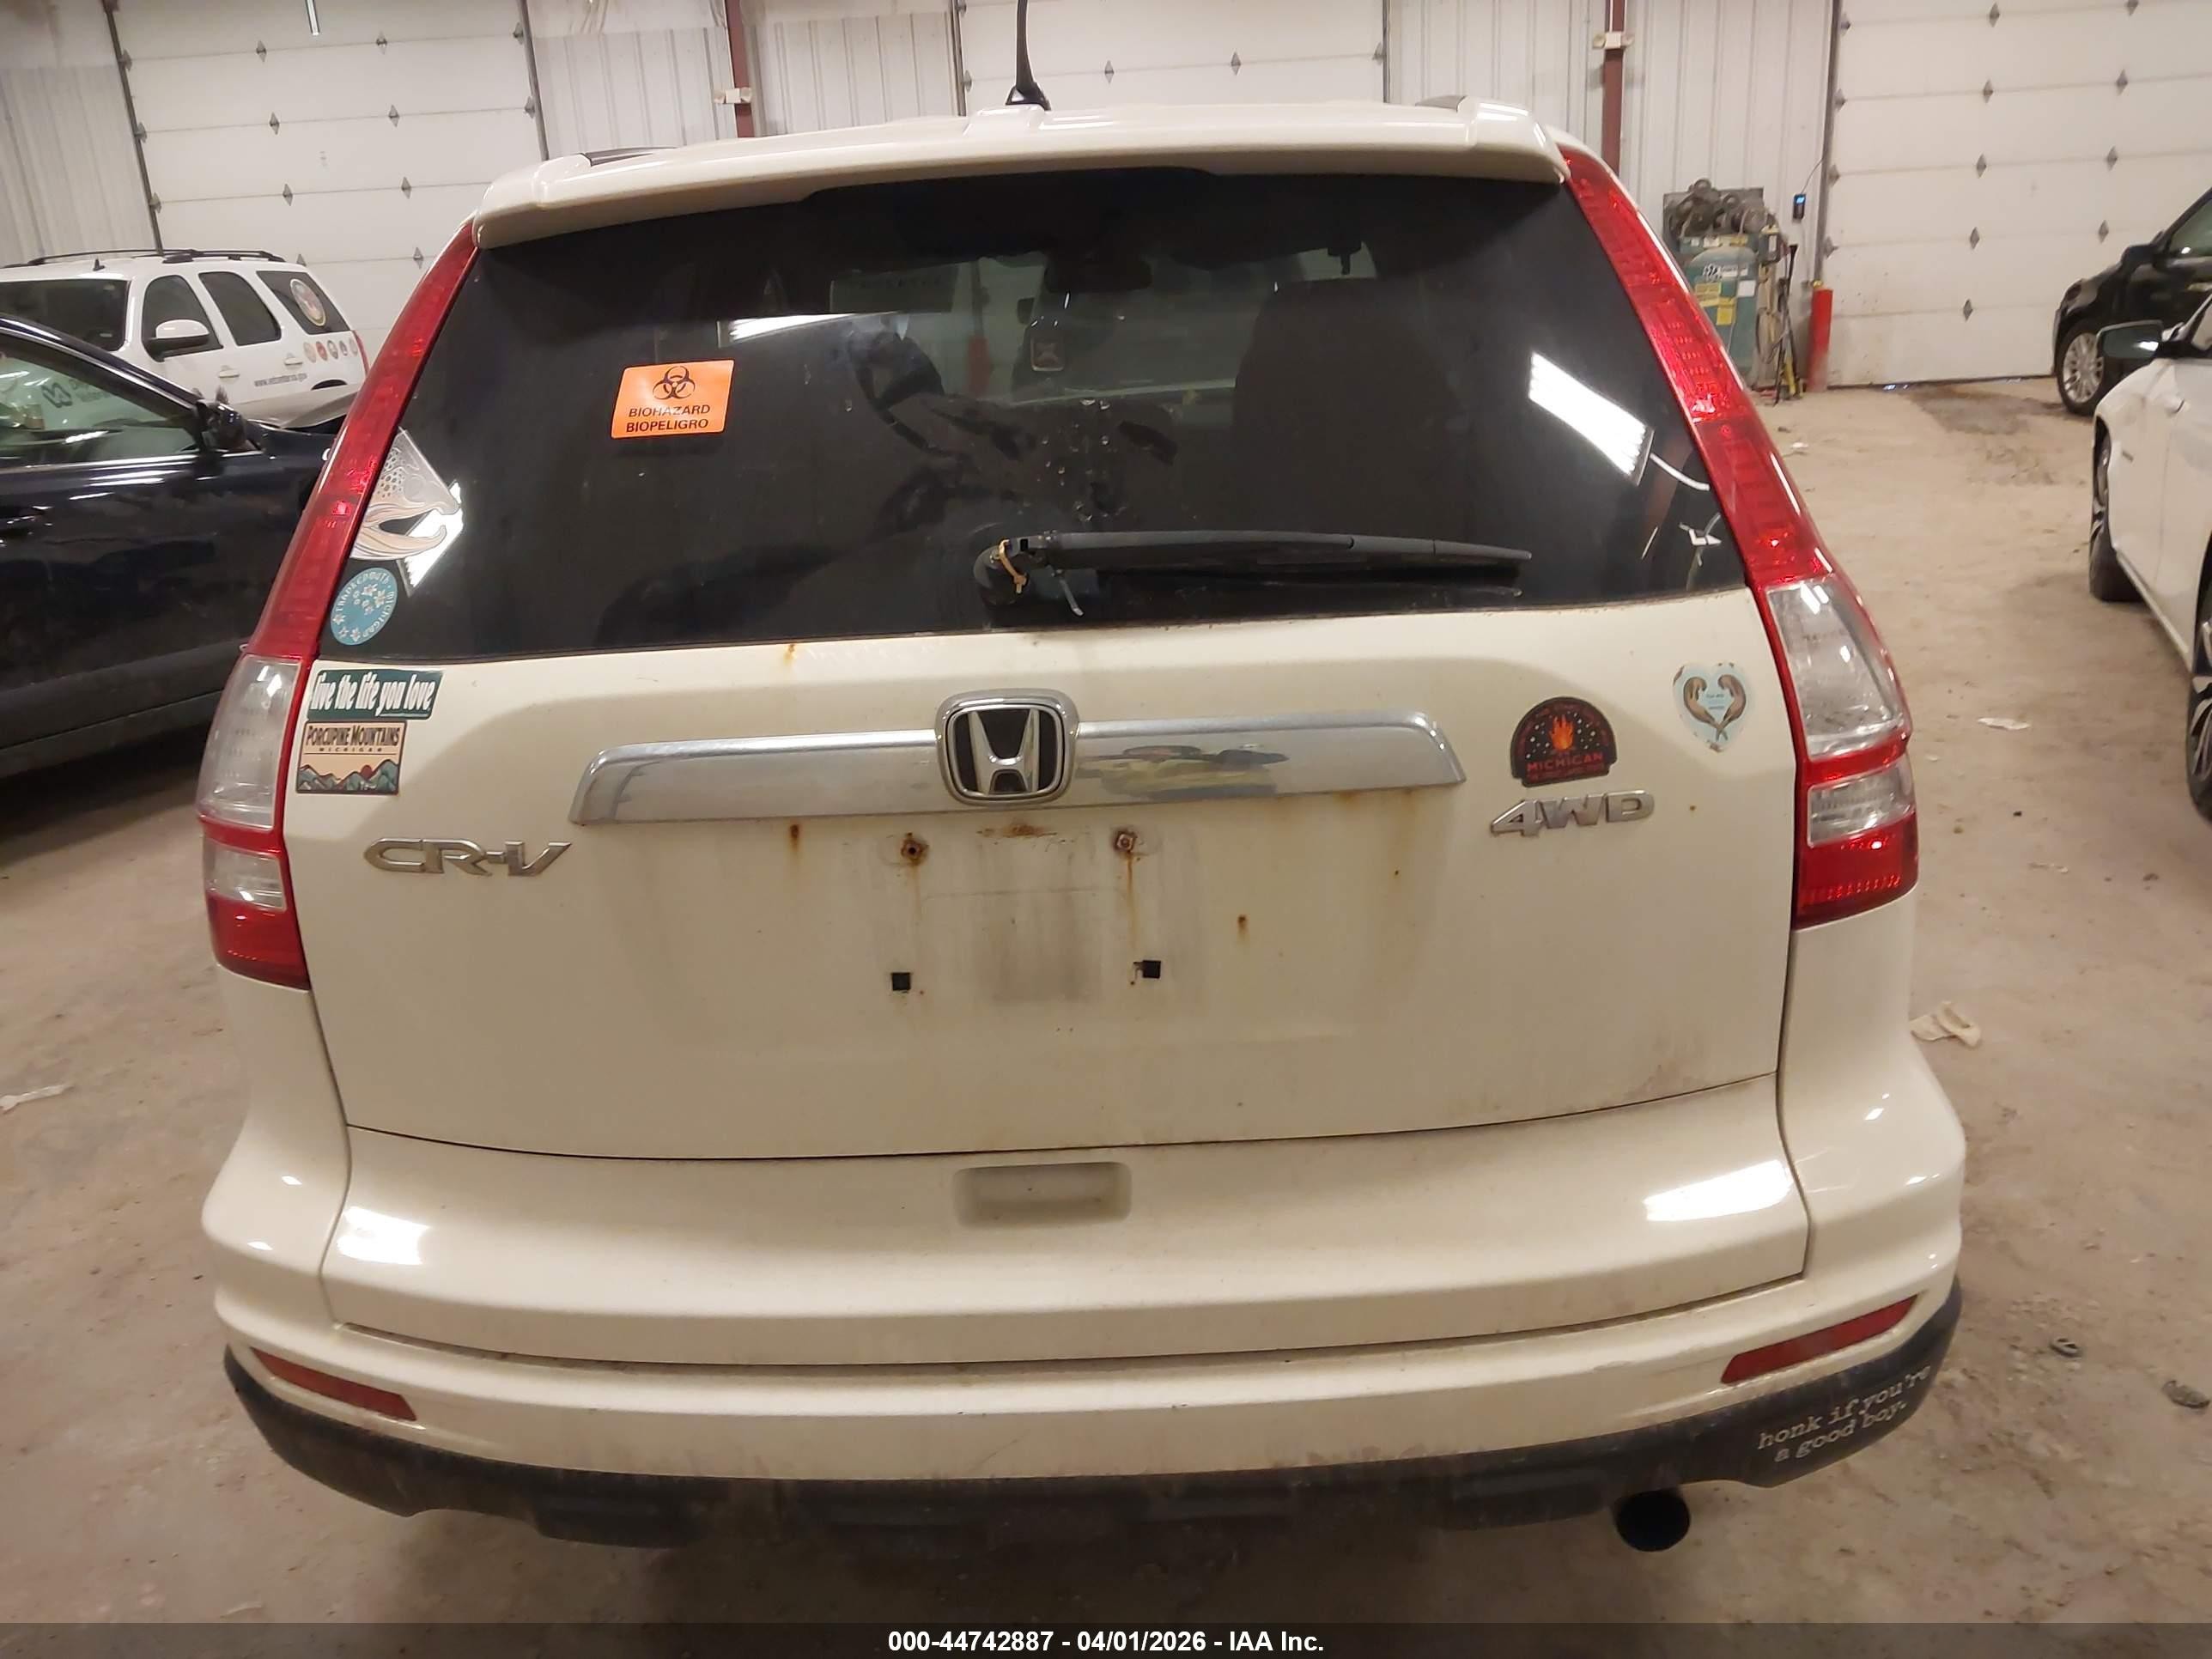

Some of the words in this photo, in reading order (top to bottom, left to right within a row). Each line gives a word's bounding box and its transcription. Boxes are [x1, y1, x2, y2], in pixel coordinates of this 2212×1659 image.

[626, 418, 709, 433] BIOPELIGRO
[628, 404, 711, 417] BIOHAZARD
[310, 672, 336, 710] live
[334, 674, 357, 710] the
[355, 672, 381, 710] life
[375, 681, 406, 717] you
[404, 674, 436, 710] love
[351, 725, 401, 747] MOUNTAINS
[1490, 789, 1656, 838] 4WD
[363, 837, 573, 877] CR-V
[1758, 1416, 1823, 1449] honk
[1827, 1398, 1860, 1425] if
[1858, 1364, 1931, 1416] you're
[1773, 1448, 1790, 1462] a
[1795, 1419, 1856, 1458] good
[1861, 1401, 1907, 1429] boy.
